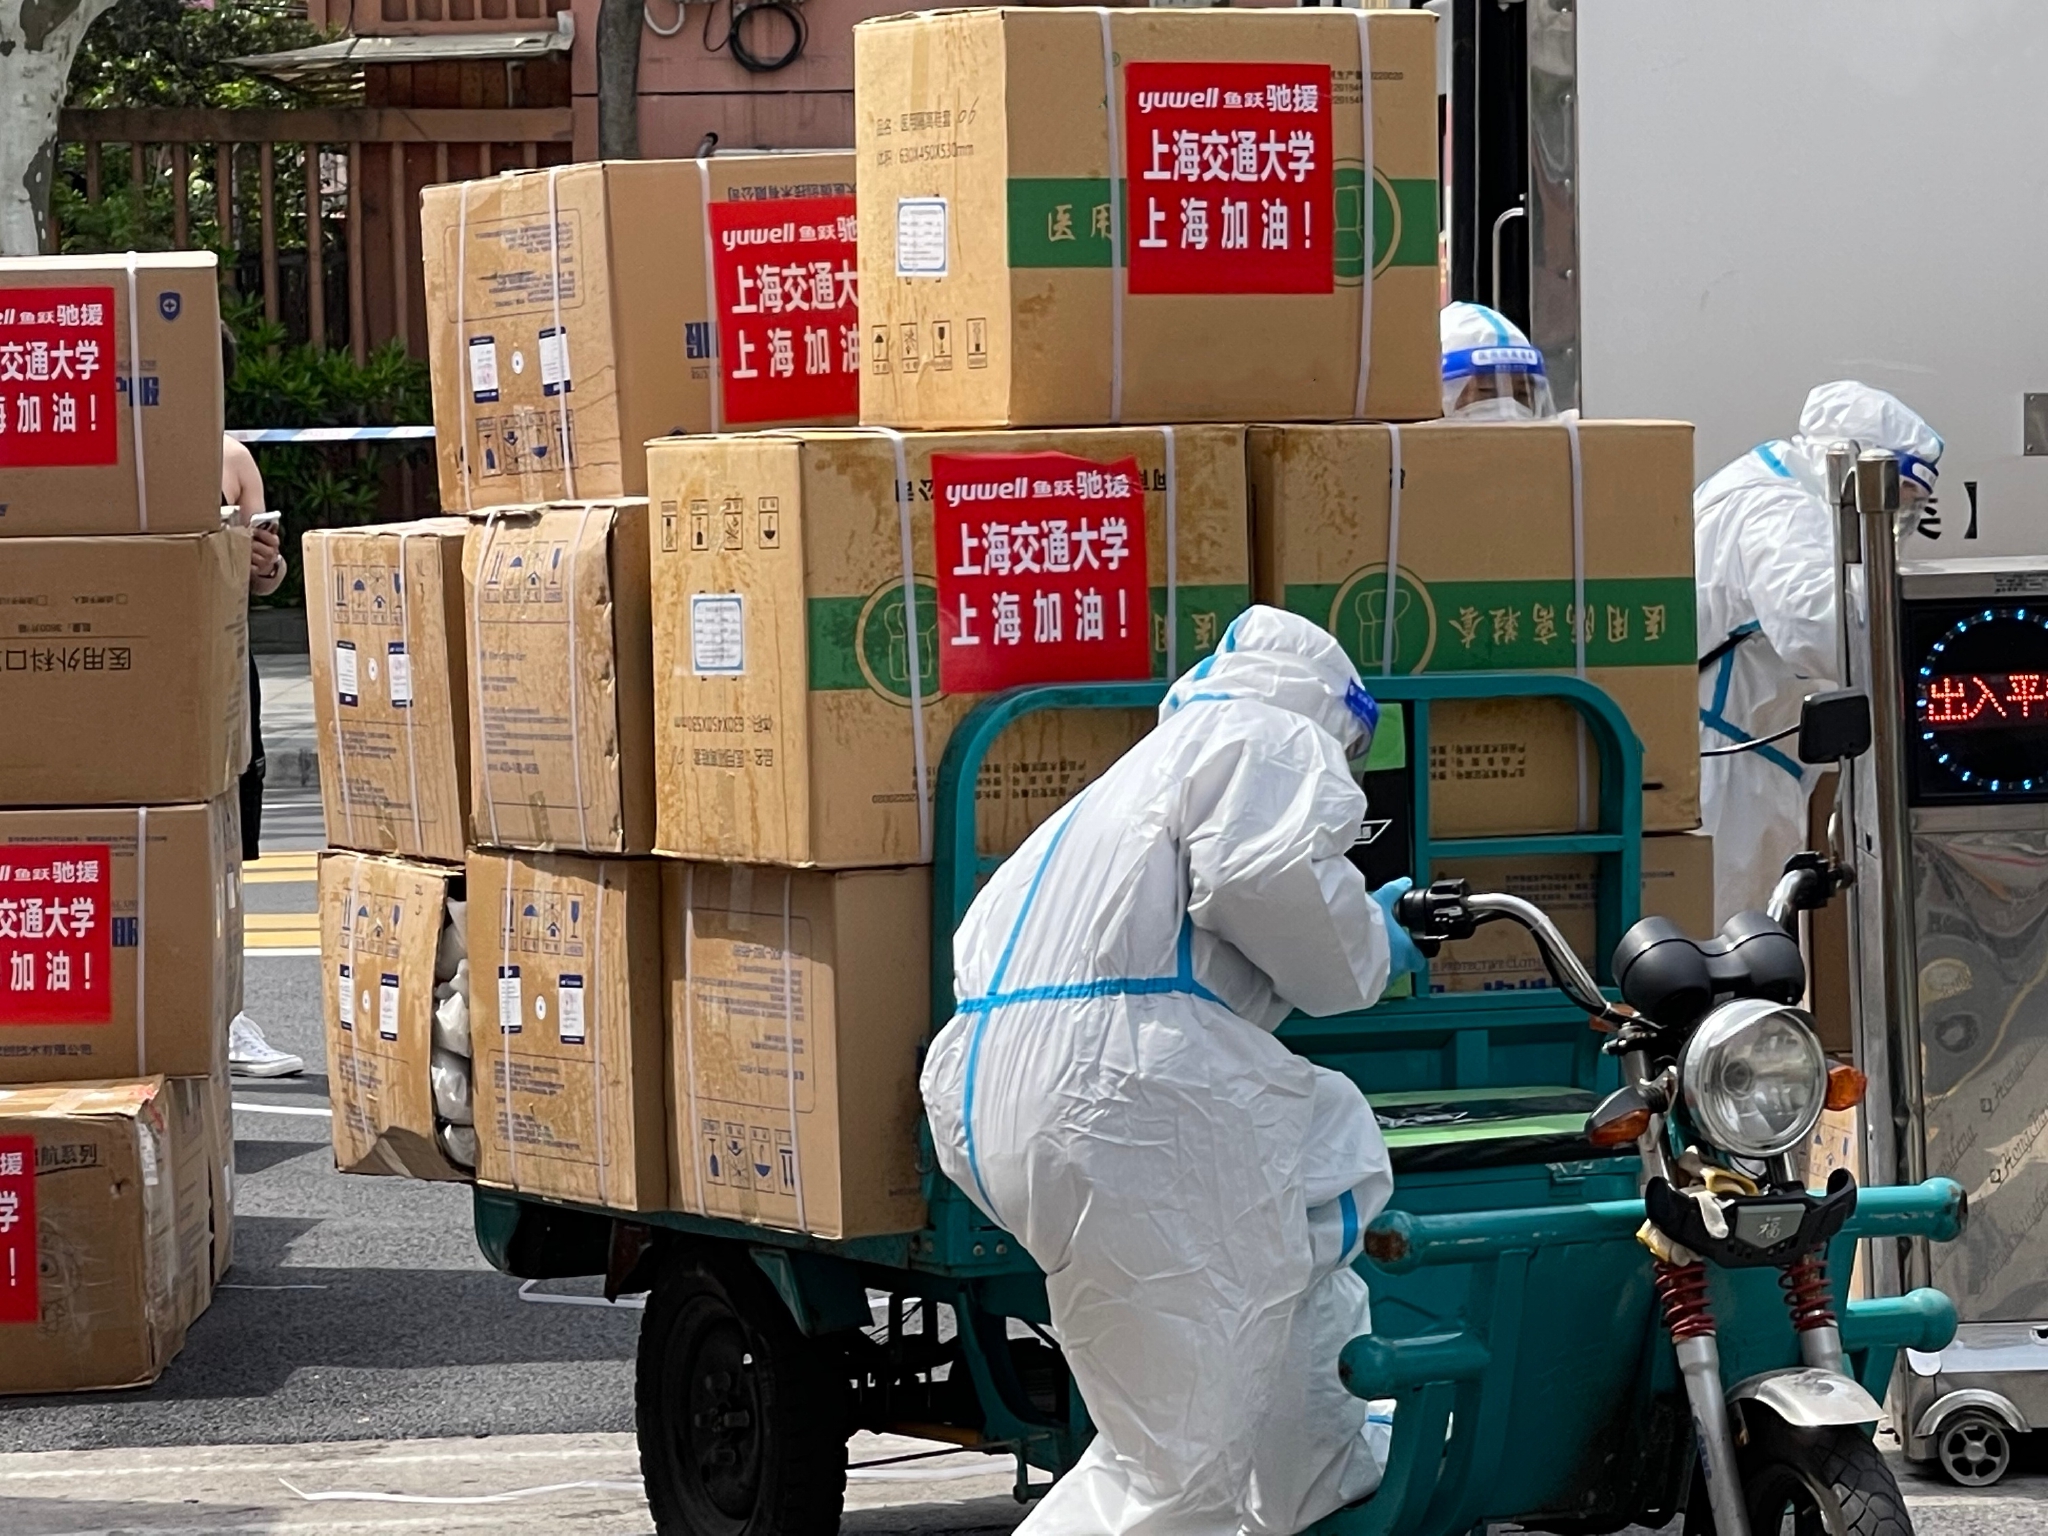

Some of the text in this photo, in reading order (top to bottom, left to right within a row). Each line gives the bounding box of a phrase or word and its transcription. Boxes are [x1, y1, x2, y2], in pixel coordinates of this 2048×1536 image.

[1138, 83, 1319, 114] yuwell 鱼跃驰援
[1143, 129, 1315, 183] 上海交通大学
[722, 222, 795, 251] yuwell
[1139, 196, 1312, 250] 上海加油!
[731, 259, 858, 314] 上海交通大
[19, 303, 103, 327] 鱼跃驰援
[0, 339, 100, 382] 交通大学
[732, 323, 859, 379] 上海加油
[0, 392, 96, 434] 加油!
[946, 470, 1131, 508] yuwell 鱼跃驰援
[953, 516, 1129, 576] 上海交通大学
[950, 588, 1127, 646] 上海加油!
[0, 646, 132, 673] 医用外科口
[1927, 673, 2048, 722] 出入平
[14, 860, 99, 883] 鱼跃驰援
[0, 896, 95, 939] 交通大学
[0, 1152, 23, 1176] 援
[35, 1143, 98, 1167] 航系列
[1756, 1216, 1782, 1240] 福
